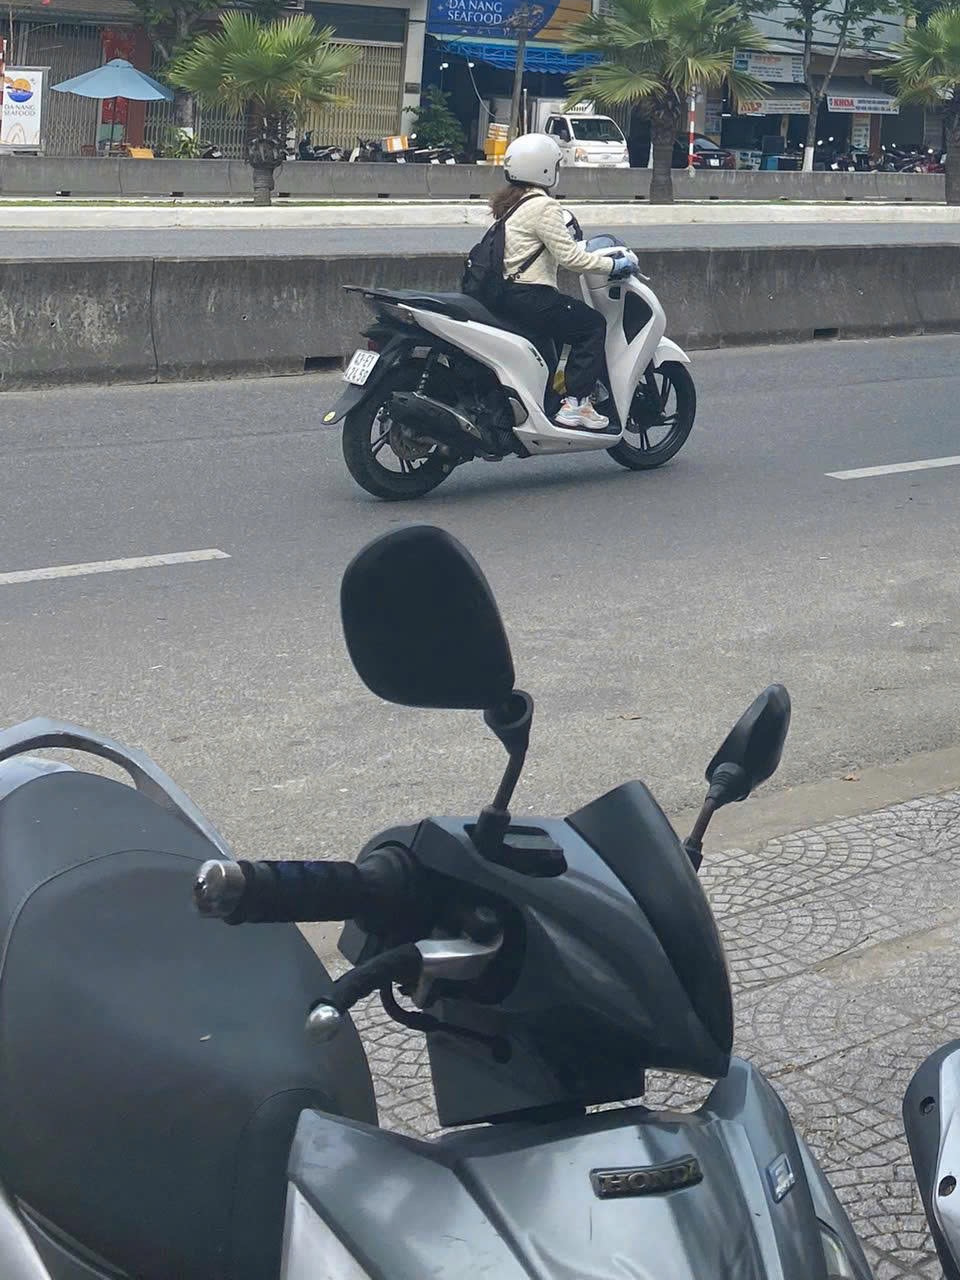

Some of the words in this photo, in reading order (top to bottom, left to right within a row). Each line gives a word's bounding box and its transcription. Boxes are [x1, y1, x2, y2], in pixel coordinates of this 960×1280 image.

[468, 0, 503, 13] NANG
[447, 10, 503, 24] SEAFOOD
[832, 98, 855, 107] KHOA
